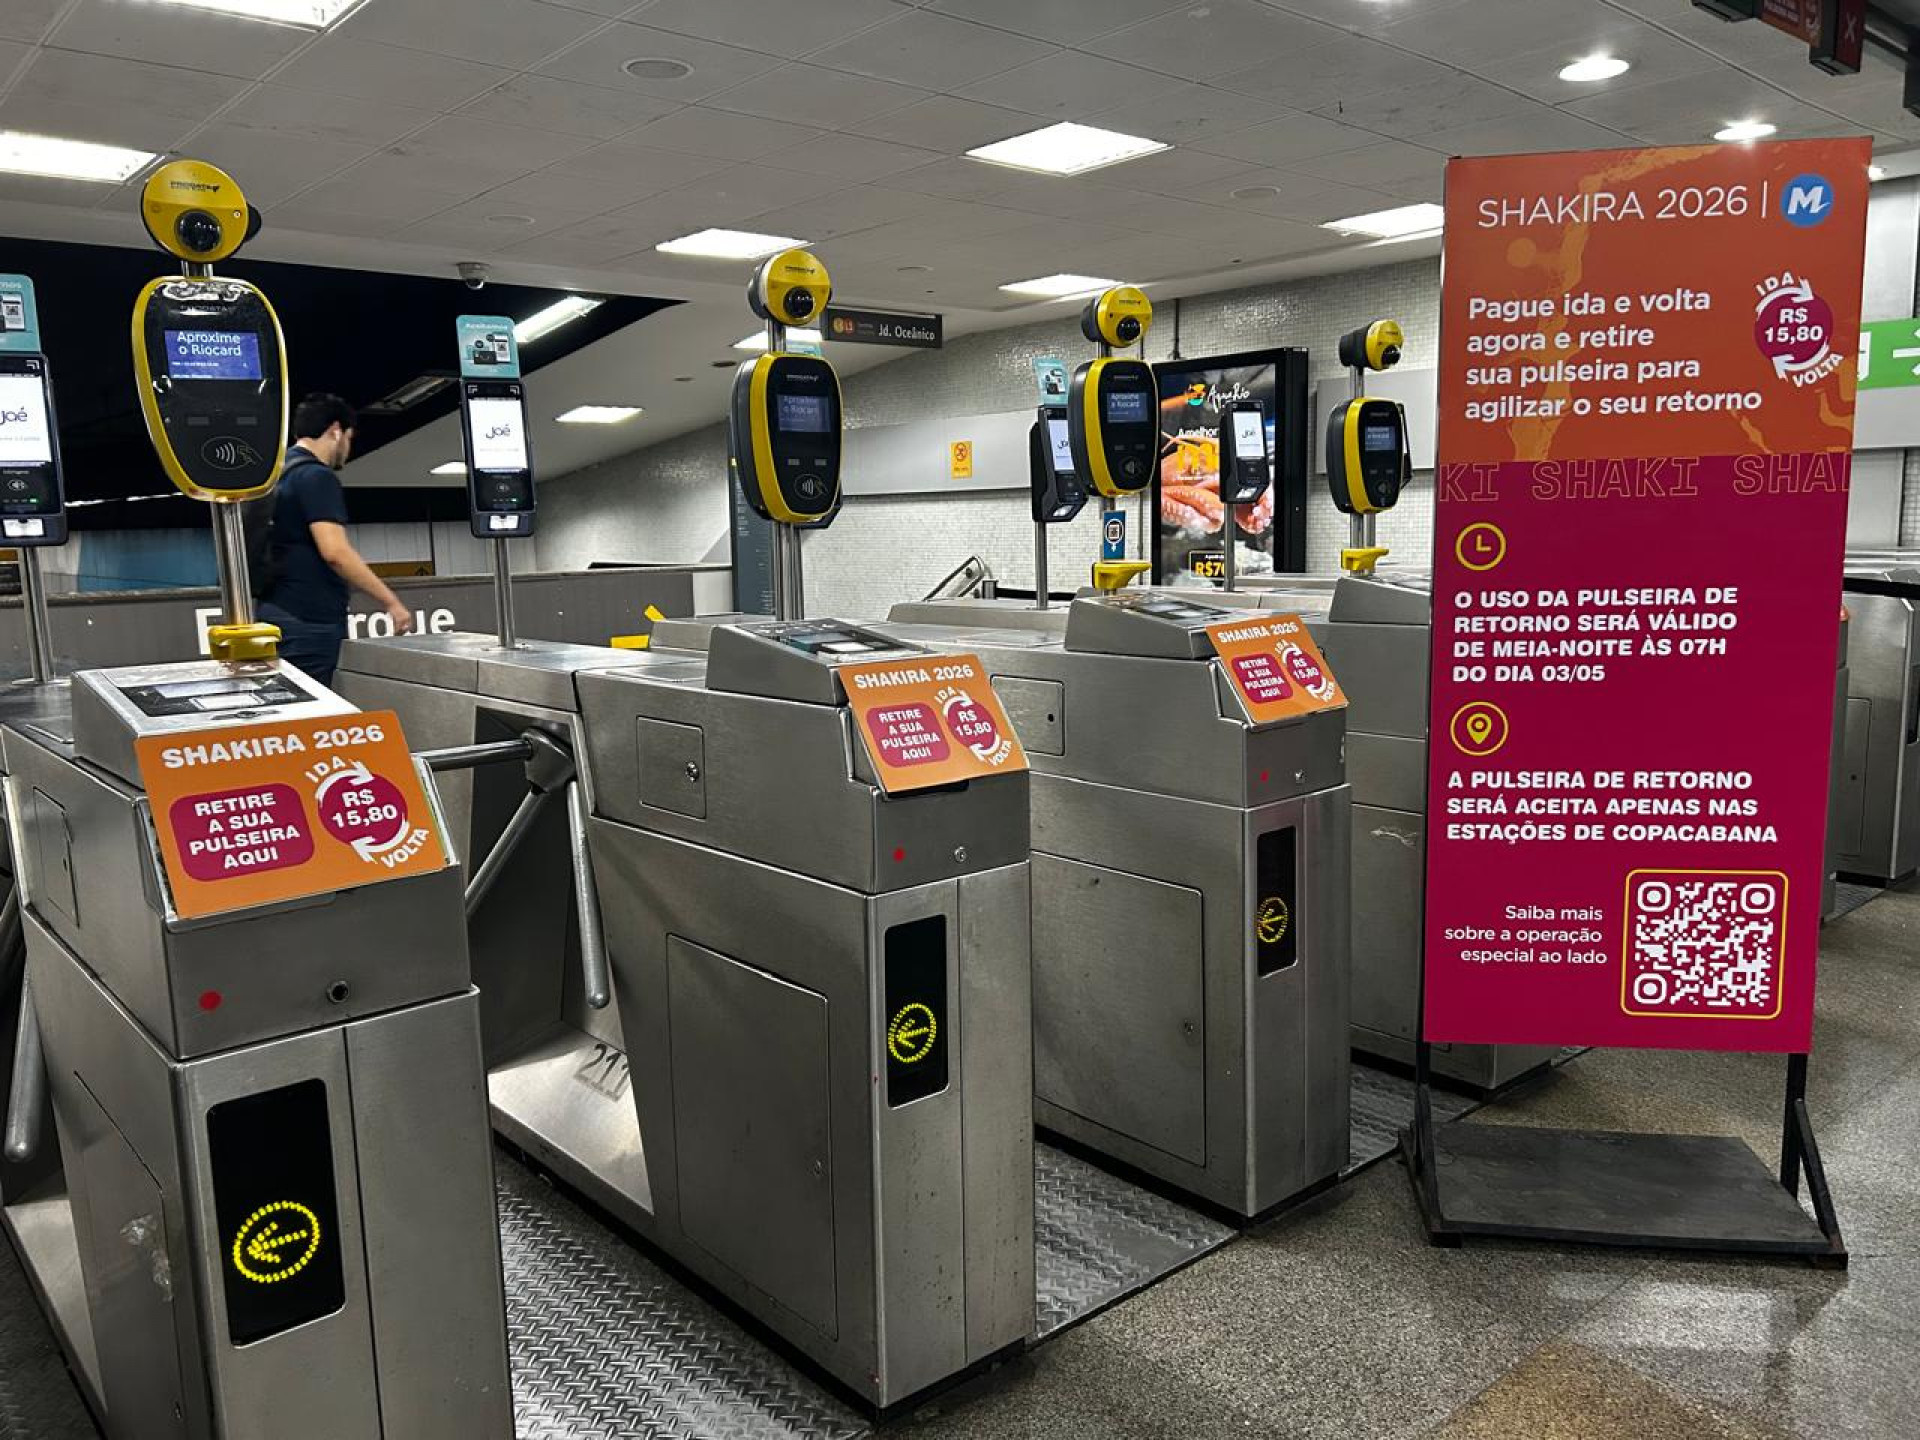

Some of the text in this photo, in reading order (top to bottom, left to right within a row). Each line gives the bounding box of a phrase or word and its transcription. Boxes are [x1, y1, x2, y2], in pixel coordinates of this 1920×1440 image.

[1479, 192, 1644, 227] SHAKIRA
[1656, 186, 1747, 218] 2026
[1756, 271, 1794, 296] IDA
[1470, 288, 1710, 322] Pague ida e volta
[1780, 308, 1807, 324] R$
[177, 332, 241, 344] Aproxime
[879, 324, 892, 337] Jd.
[895, 325, 936, 340] Oceânico
[1467, 324, 1653, 356] agora e retire
[1765, 326, 1823, 344] 15,80
[178, 345, 241, 356] o Riocard
[1467, 359, 1700, 387] sua pulseira para
[1792, 354, 1844, 387] VOLTA
[1466, 391, 1761, 422] agilizar o seu retorno
[1532, 456, 1699, 500] SHAKI
[1455, 588, 1737, 608] O USO DA PULSEIRA DE
[1455, 609, 1737, 633] RETORNO SERÁ VÁLIDO
[1454, 634, 1725, 657] DE MEIA-NOITE ÀS 07H
[855, 665, 974, 688] SHAKIRA 2026
[1453, 665, 1605, 682] DO DIA 03/05
[934, 686, 956, 704] IDA
[879, 709, 922, 723] RETIRE
[958, 710, 977, 722] R$
[889, 722, 924, 735] A SUA
[956, 722, 991, 735] 15,80
[162, 725, 384, 768] SHAKIRA 2026
[882, 732, 940, 749] PULSEIRA
[903, 747, 931, 759] AQUI
[989, 740, 1012, 766] VOLTA
[305, 755, 346, 782] IDA
[1449, 771, 1752, 789] A PULSEIRA DE RETORNO
[195, 793, 276, 816] RETIRE
[342, 789, 375, 807] R$
[1447, 794, 1757, 816] SERÁ ACEITA APENAS NAS
[210, 811, 273, 833] A SUA
[333, 805, 397, 827] 15,80
[190, 825, 300, 855] PULSEIRA
[1448, 821, 1777, 844] ESTAÇÕES DE COPACABANA
[225, 847, 278, 868] AQUI
[380, 828, 430, 868] VOLTA
[1506, 906, 1602, 920] Saiba mais
[1445, 926, 1602, 944] sobre a operação
[1461, 948, 1607, 963] especial ao lado
